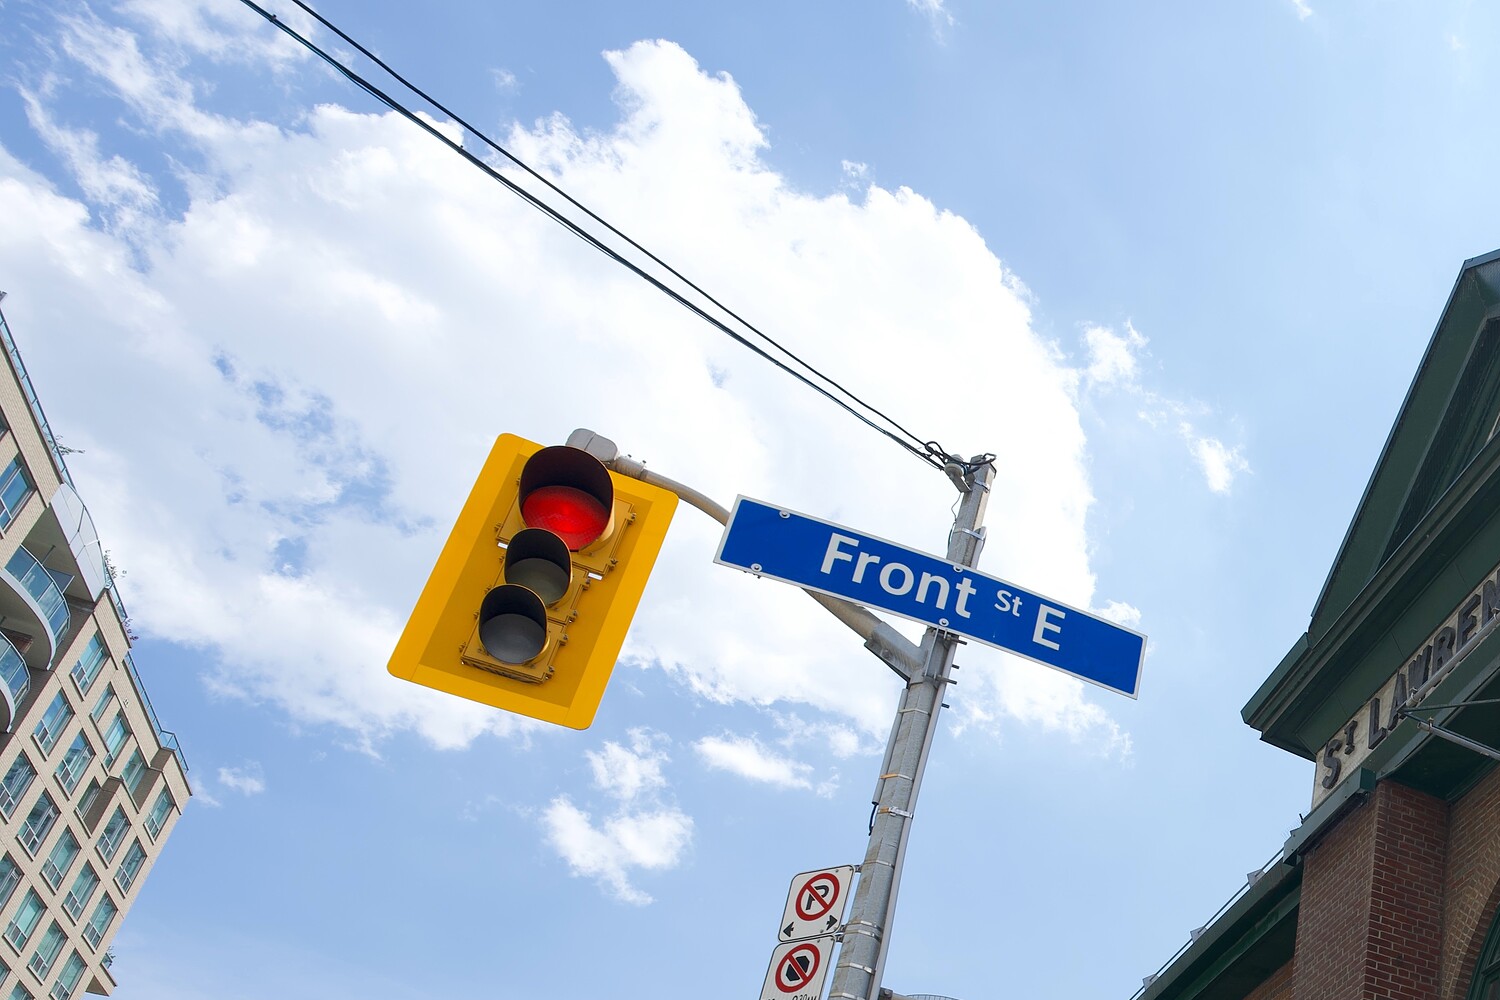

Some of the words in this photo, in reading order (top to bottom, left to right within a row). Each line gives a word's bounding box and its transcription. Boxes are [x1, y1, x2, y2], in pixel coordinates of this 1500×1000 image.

[820, 531, 977, 619] Front
[994, 588, 1023, 617] St
[1032, 603, 1066, 651] E
